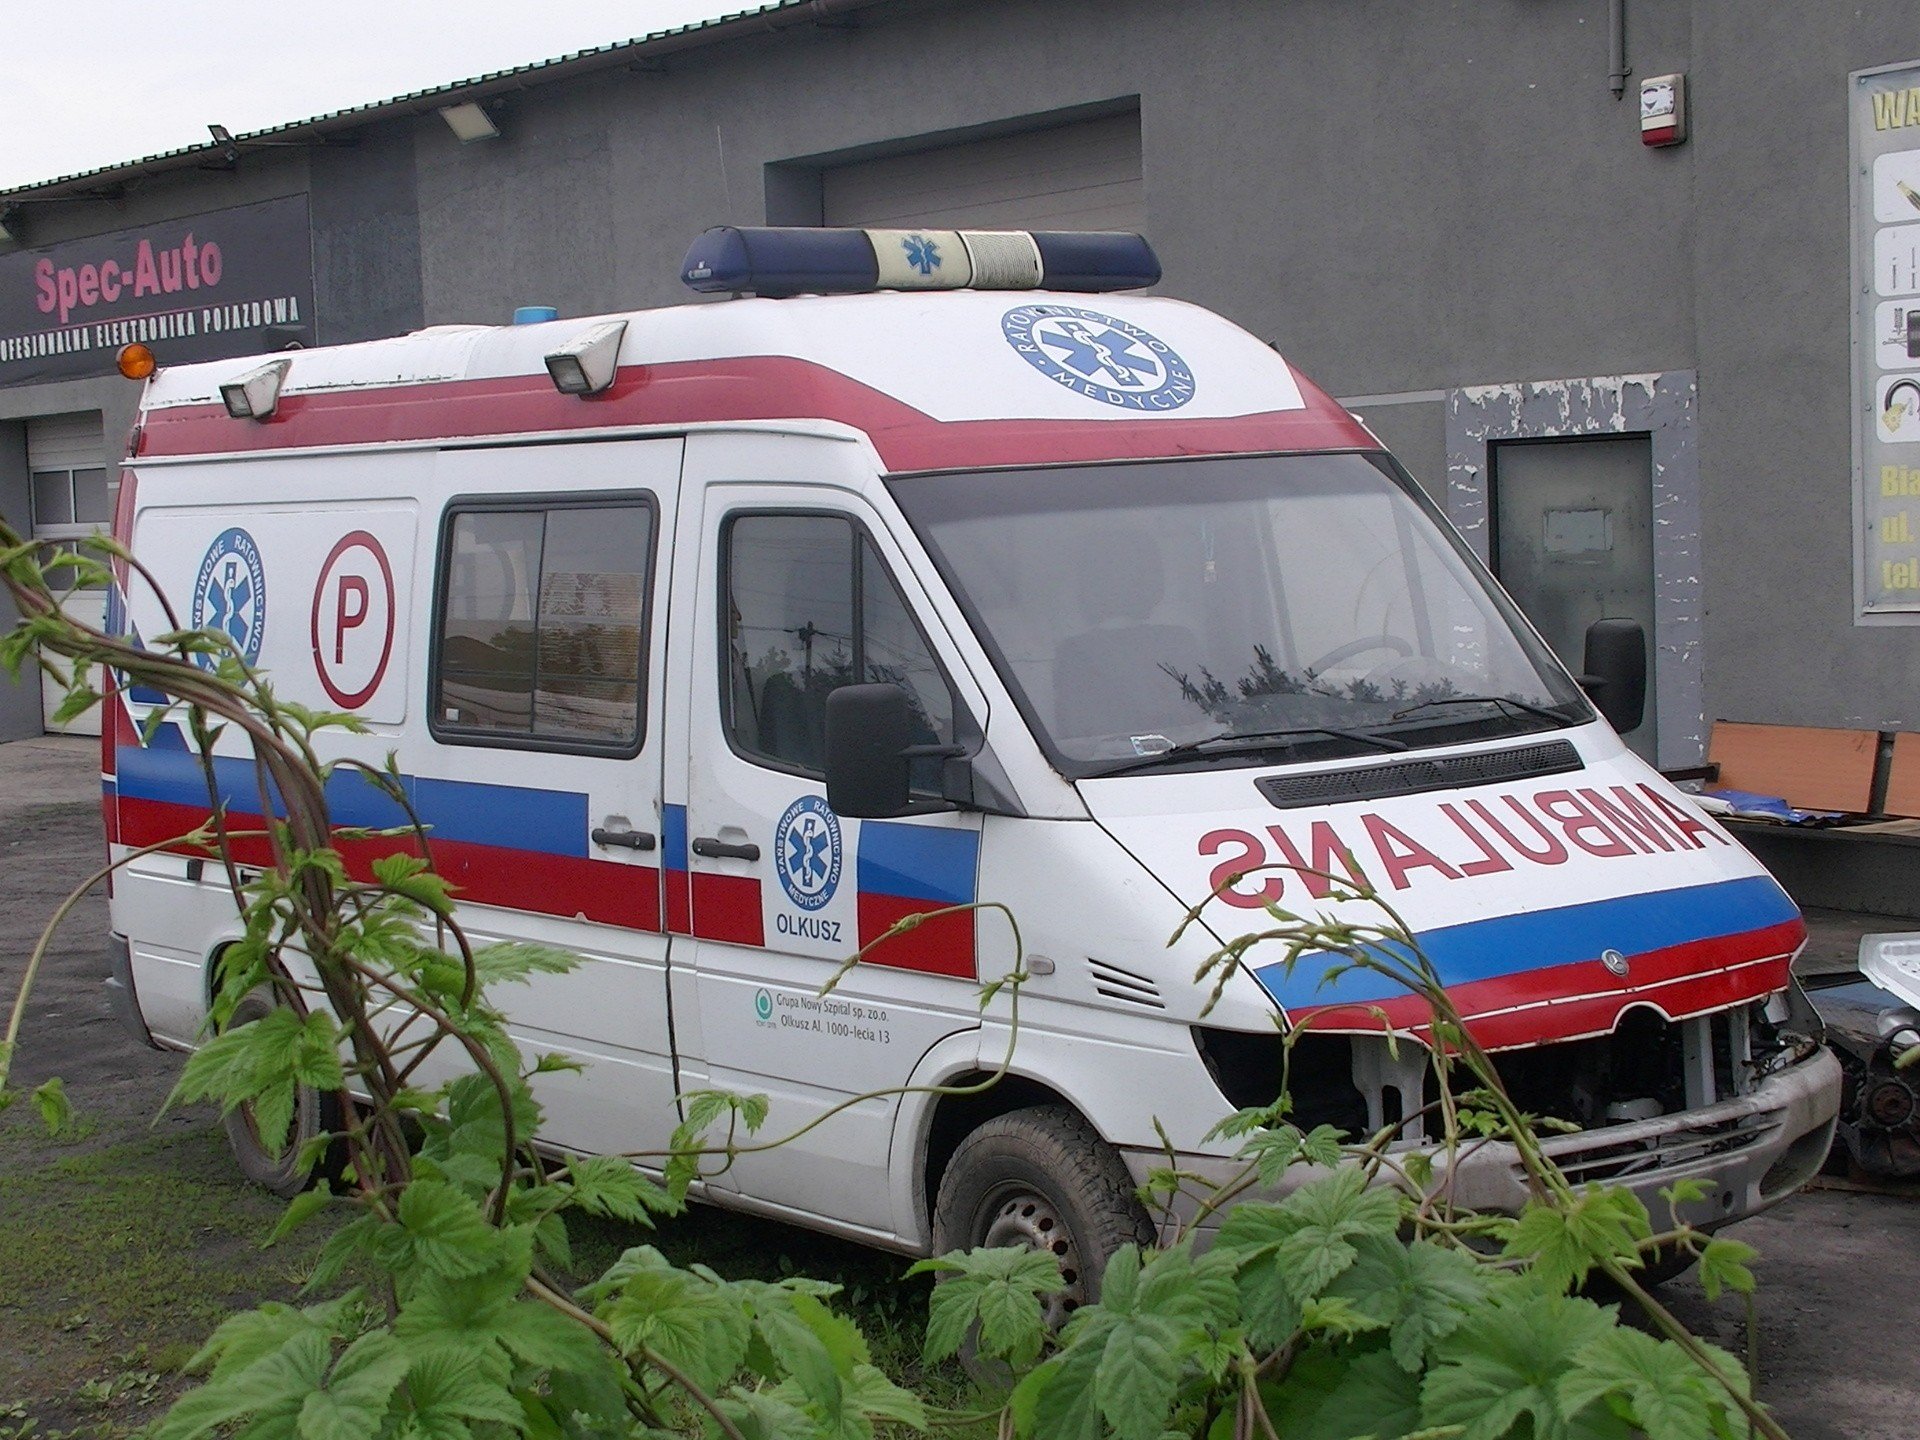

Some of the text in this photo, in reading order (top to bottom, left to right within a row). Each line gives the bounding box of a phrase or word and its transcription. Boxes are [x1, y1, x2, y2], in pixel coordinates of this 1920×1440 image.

[35, 233, 222, 323] Spec-Auto
[97, 311, 196, 348] ELEKTRONIKA
[203, 296, 299, 333] POJAZDOWA
[1006, 306, 1168, 353] RATOWNICTWO
[1052, 370, 1192, 409] MEDYCZNE
[1881, 510, 1915, 544] ul.
[234, 534, 263, 652] RATOWNICTWO
[335, 575, 370, 665] P
[813, 800, 841, 884] RATOWNICTWO
[787, 884, 829, 907] MEDYCZNE
[776, 913, 842, 943] OLKUSZ
[776, 993, 799, 1008] Grupa
[801, 997, 822, 1013] Nowy
[824, 1000, 850, 1016] Szpital
[852, 1007, 866, 1020] sp.
[781, 1014, 810, 1031] Olkusz
[811, 1018, 823, 1033] Al.
[826, 1021, 876, 1042] 1000-lecia
[879, 1029, 890, 1044] 13
